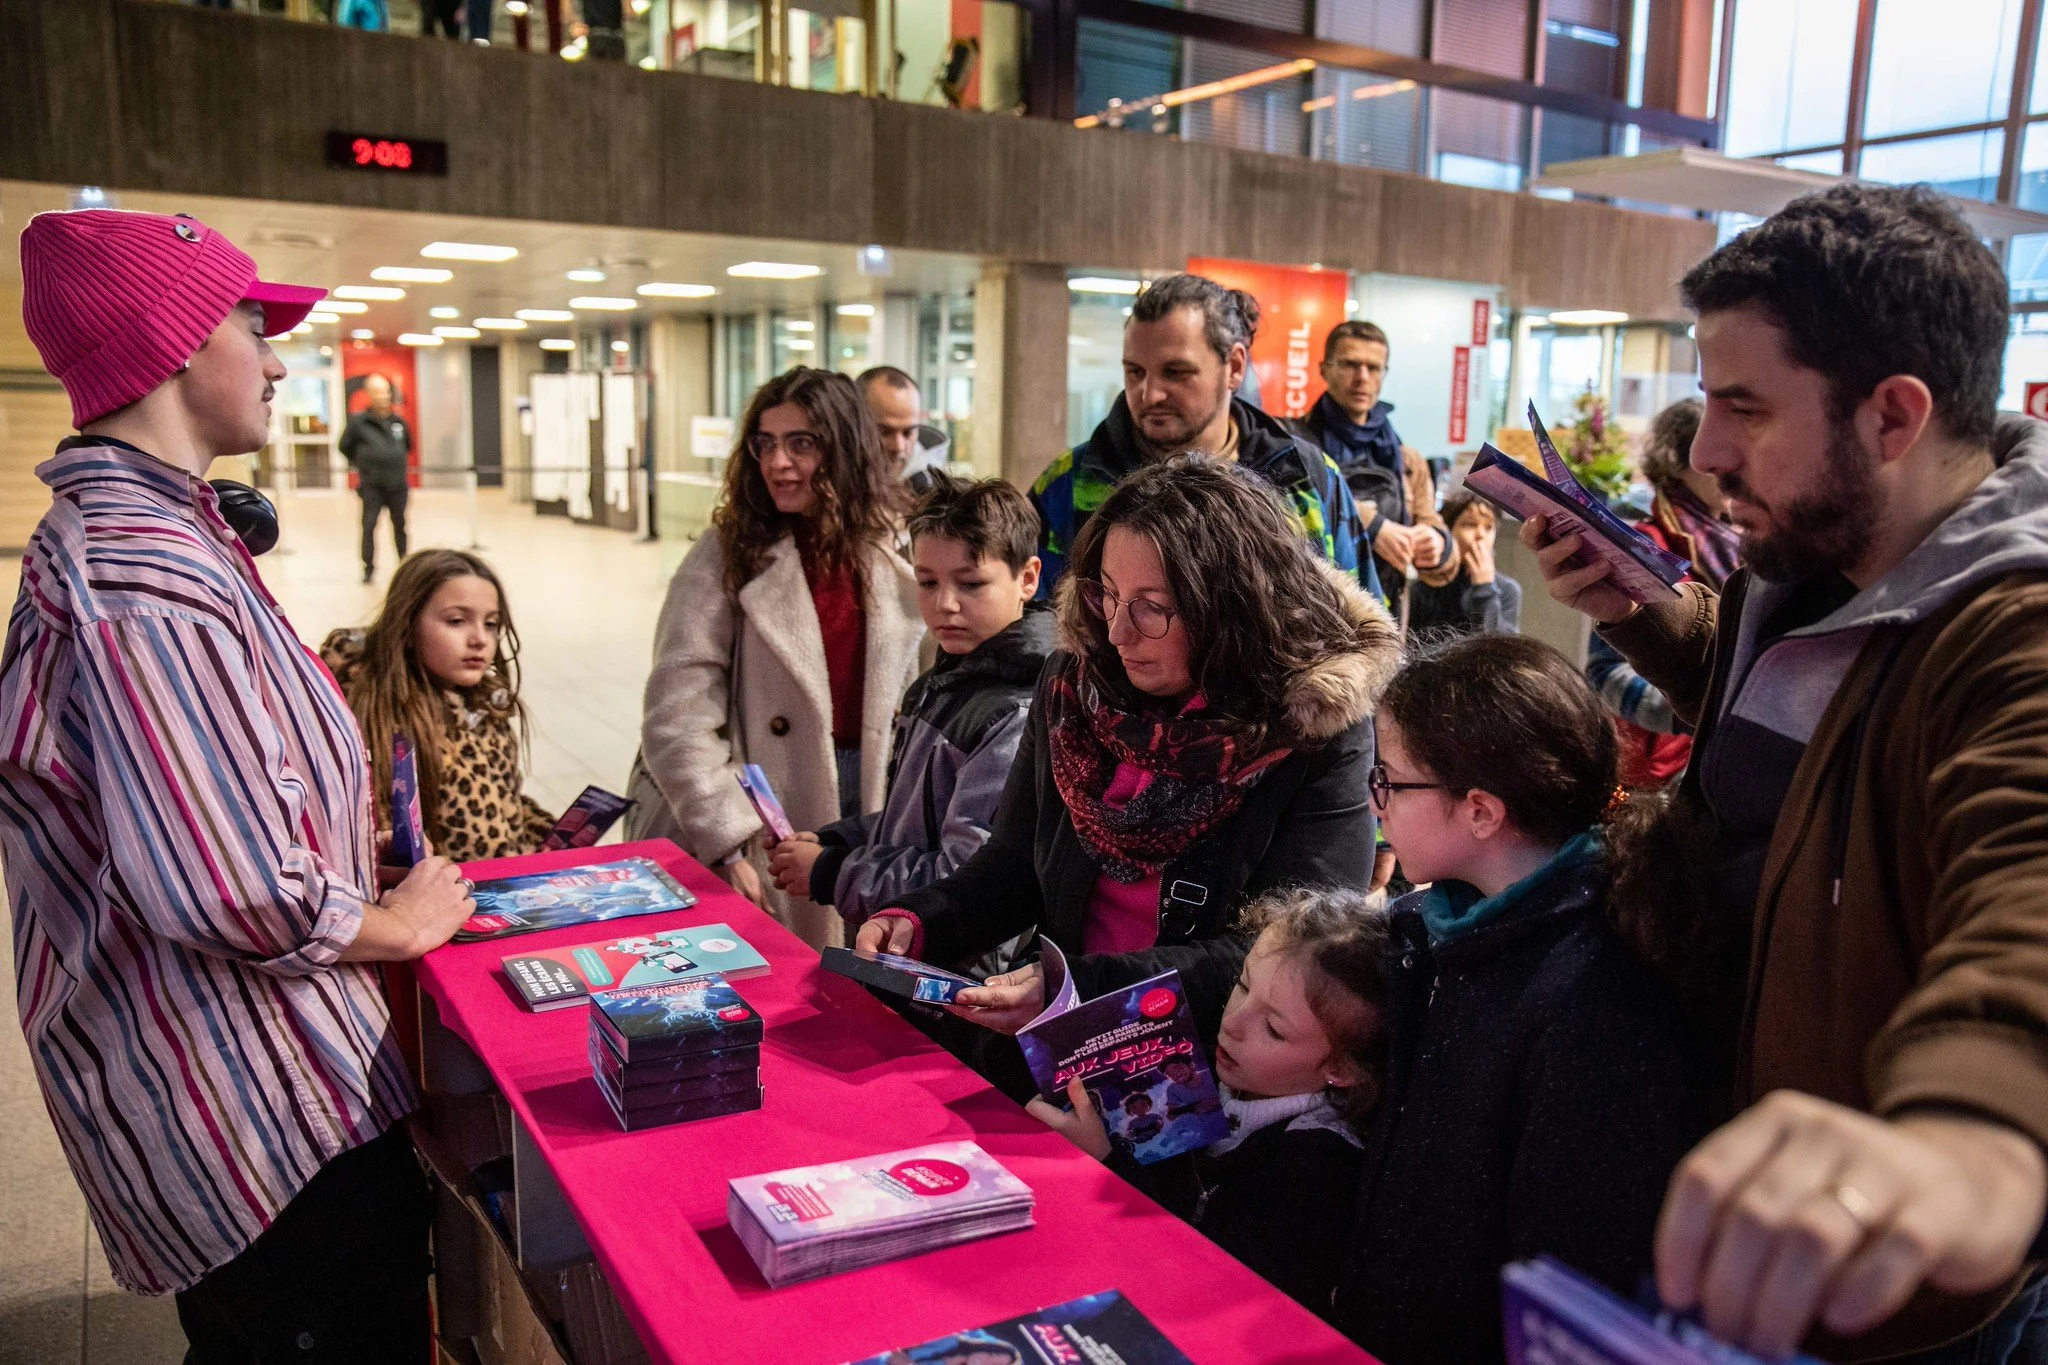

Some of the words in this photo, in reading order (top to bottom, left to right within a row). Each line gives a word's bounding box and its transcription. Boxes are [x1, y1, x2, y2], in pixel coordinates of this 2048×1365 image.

[513, 960, 537, 984] ENFANT,
[529, 960, 553, 983] ÉCRANS
[528, 982, 547, 998] MON
[544, 981, 561, 995] LES
[561, 983, 577, 993] ET
[1058, 1052, 1082, 1067] DONT
[1082, 1046, 1099, 1057] LES
[1099, 1032, 1139, 1050] ENFANTS
[1139, 1020, 1174, 1036] JOUENT
[1074, 1040, 1098, 1055] POUR
[1097, 1035, 1115, 1047] LES
[1114, 1021, 1155, 1042] PARENTS
[1085, 1030, 1112, 1045] PETIT
[1113, 1021, 1141, 1035] GUIDE
[1054, 1057, 1101, 1084] AUX
[1103, 1037, 1165, 1065] JEUX
